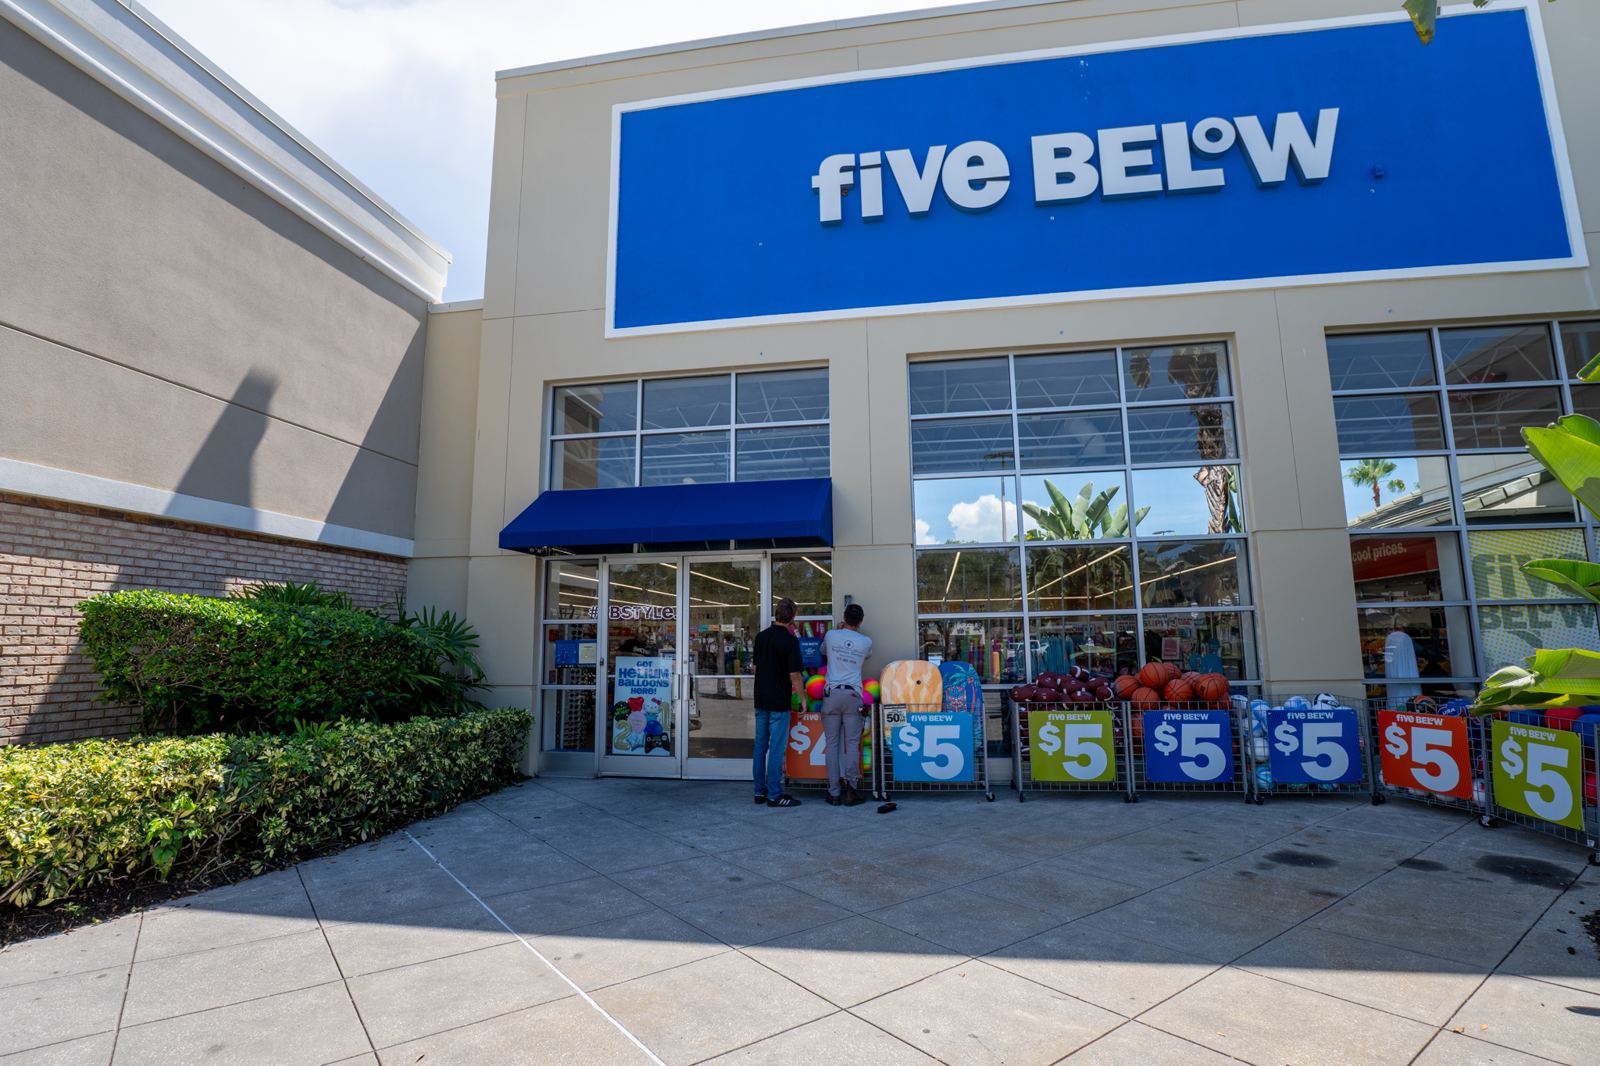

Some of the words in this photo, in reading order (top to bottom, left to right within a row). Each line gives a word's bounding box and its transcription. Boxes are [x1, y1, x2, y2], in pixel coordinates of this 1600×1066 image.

[811, 139, 1011, 225] five
[1030, 107, 1340, 207] BELOW
[1351, 546, 1371, 562] cool
[1373, 542, 1407, 561] prices.
[898, 722, 964, 780] $5
[1038, 721, 1108, 780] $5
[1154, 721, 1227, 780] $5
[1274, 720, 1349, 781] $5
[1385, 722, 1460, 792] $5
[1501, 735, 1573, 821] $5
